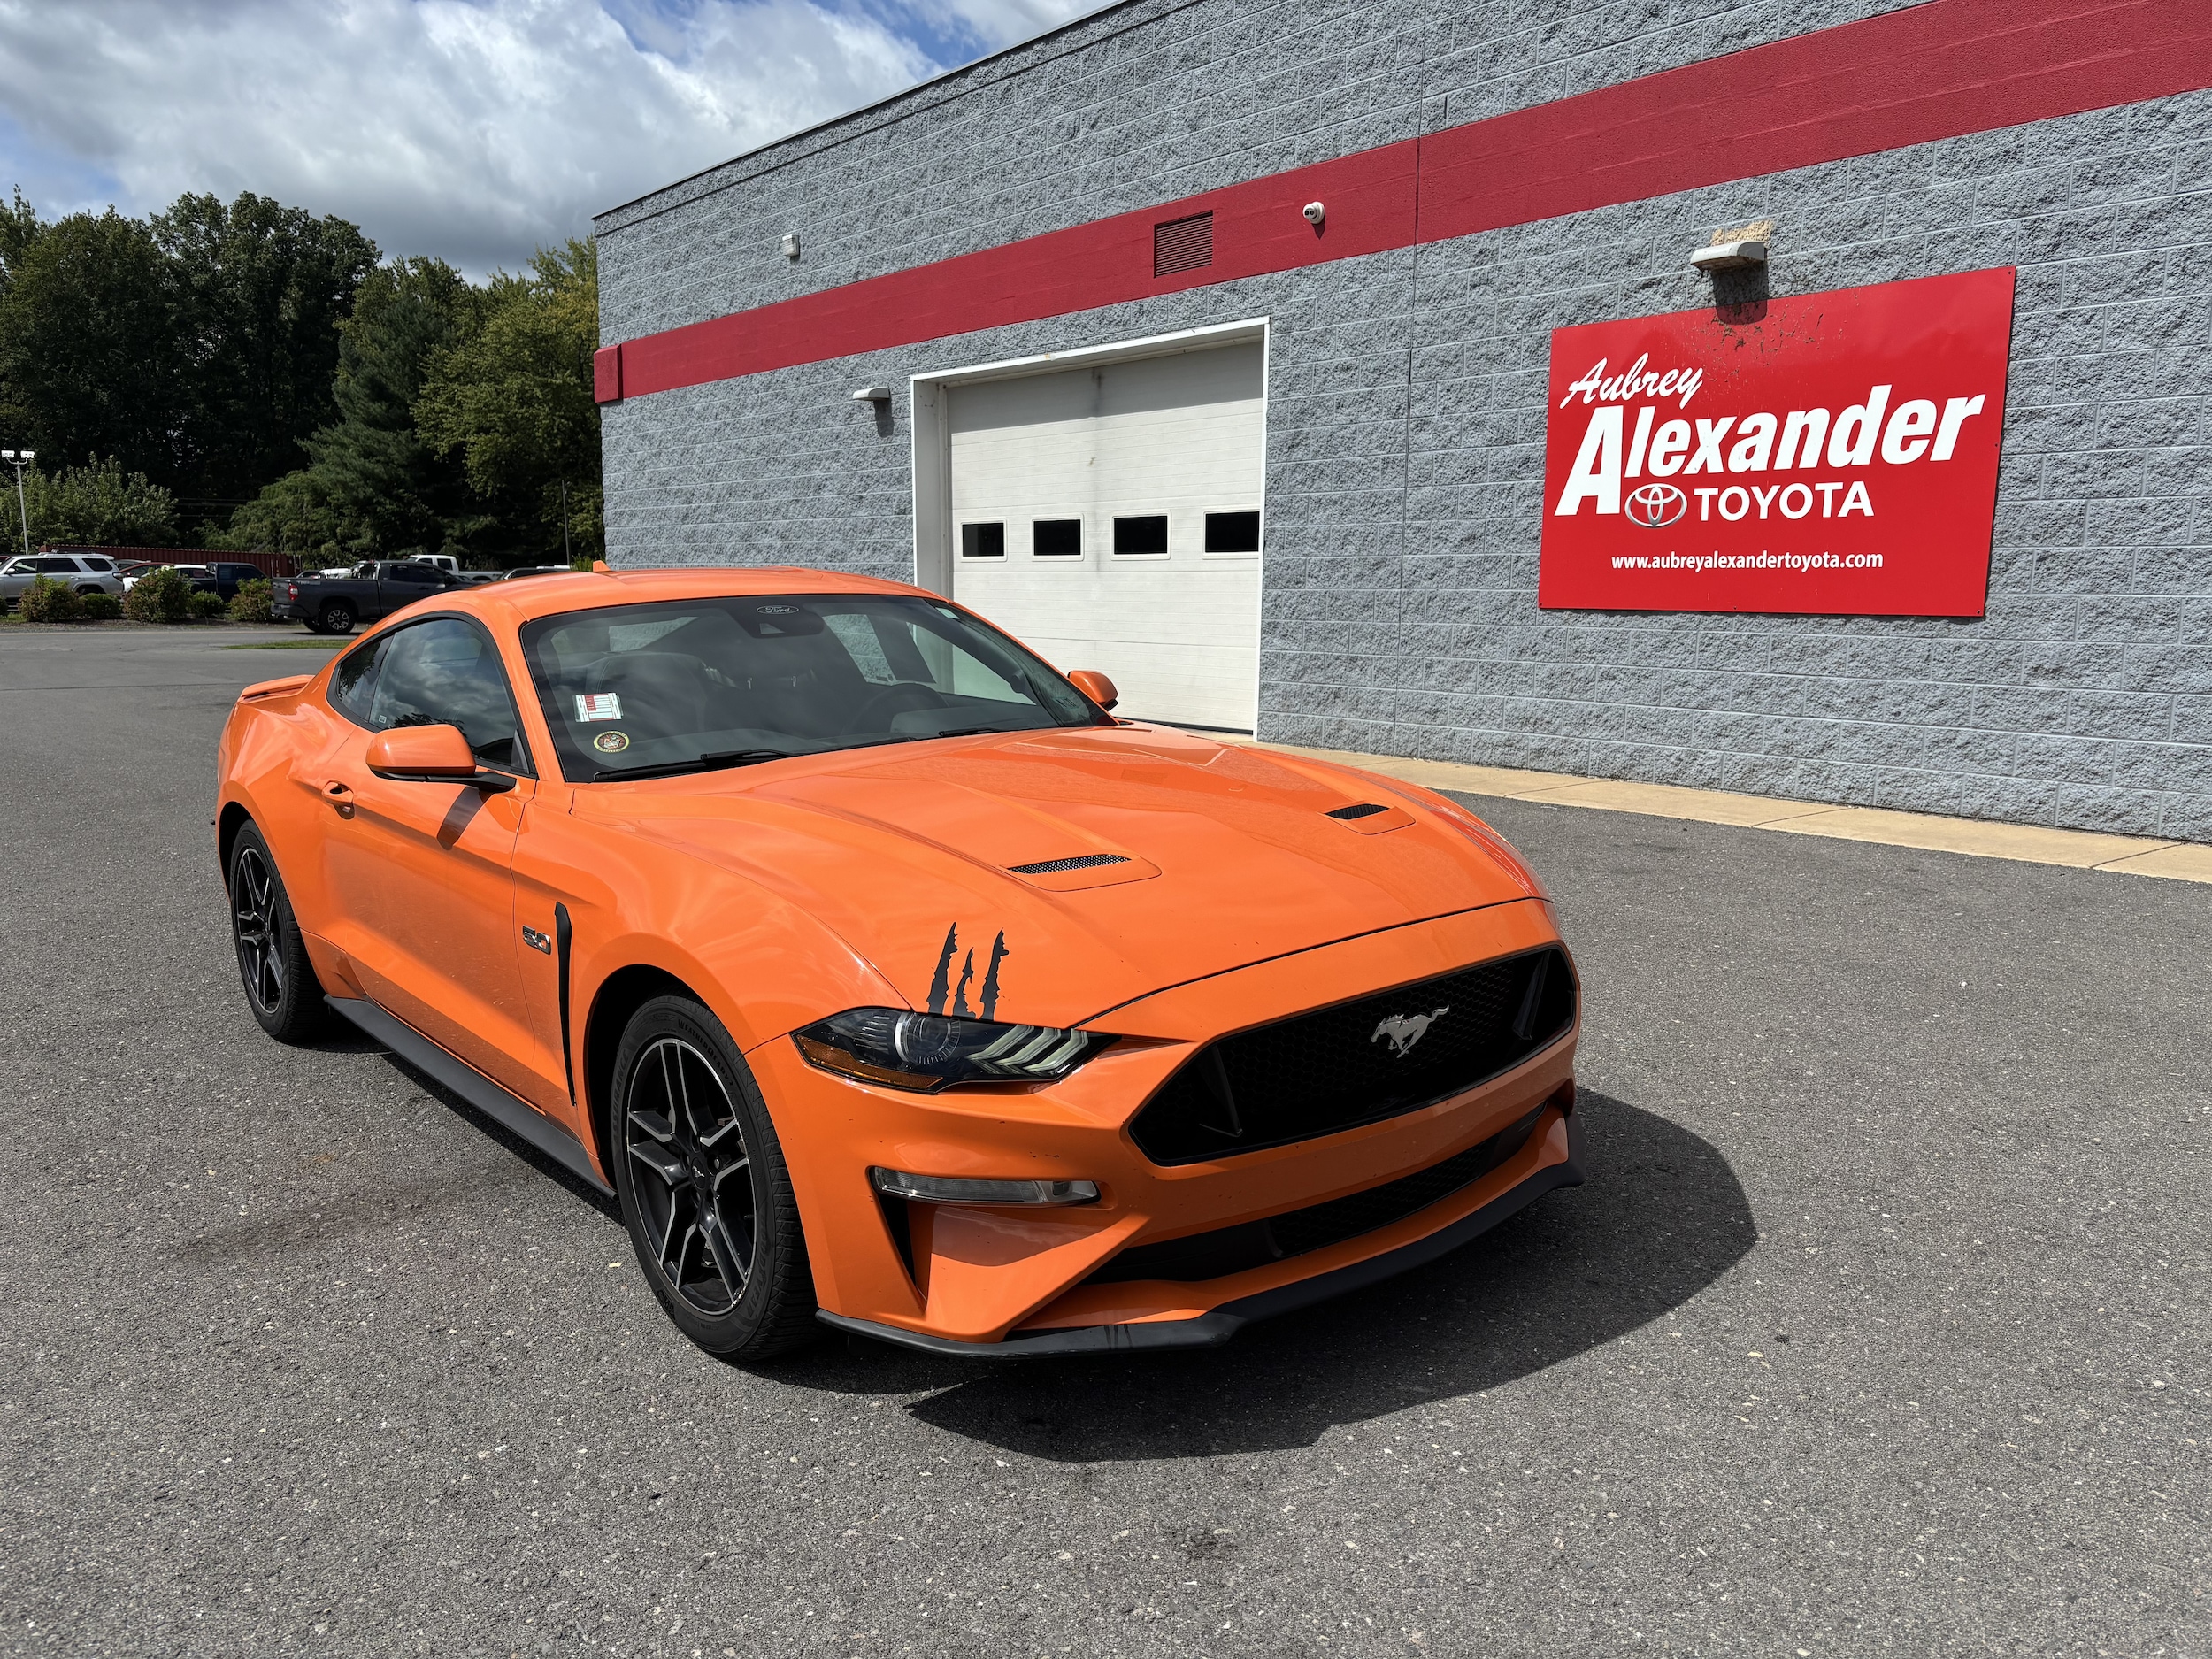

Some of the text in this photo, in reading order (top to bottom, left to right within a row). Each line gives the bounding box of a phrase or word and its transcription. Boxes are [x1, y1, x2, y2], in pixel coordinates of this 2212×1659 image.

[1560, 352, 1703, 409] Aubrey
[1555, 384, 1986, 517] Alexander
[1693, 480, 1875, 521] TOYOTA
[1611, 549, 1884, 573] www.aubreyalexandertoyota.com
[612, 1048, 629, 1145] ASSURANCE
[747, 1214, 767, 1317] GOODYEAR
